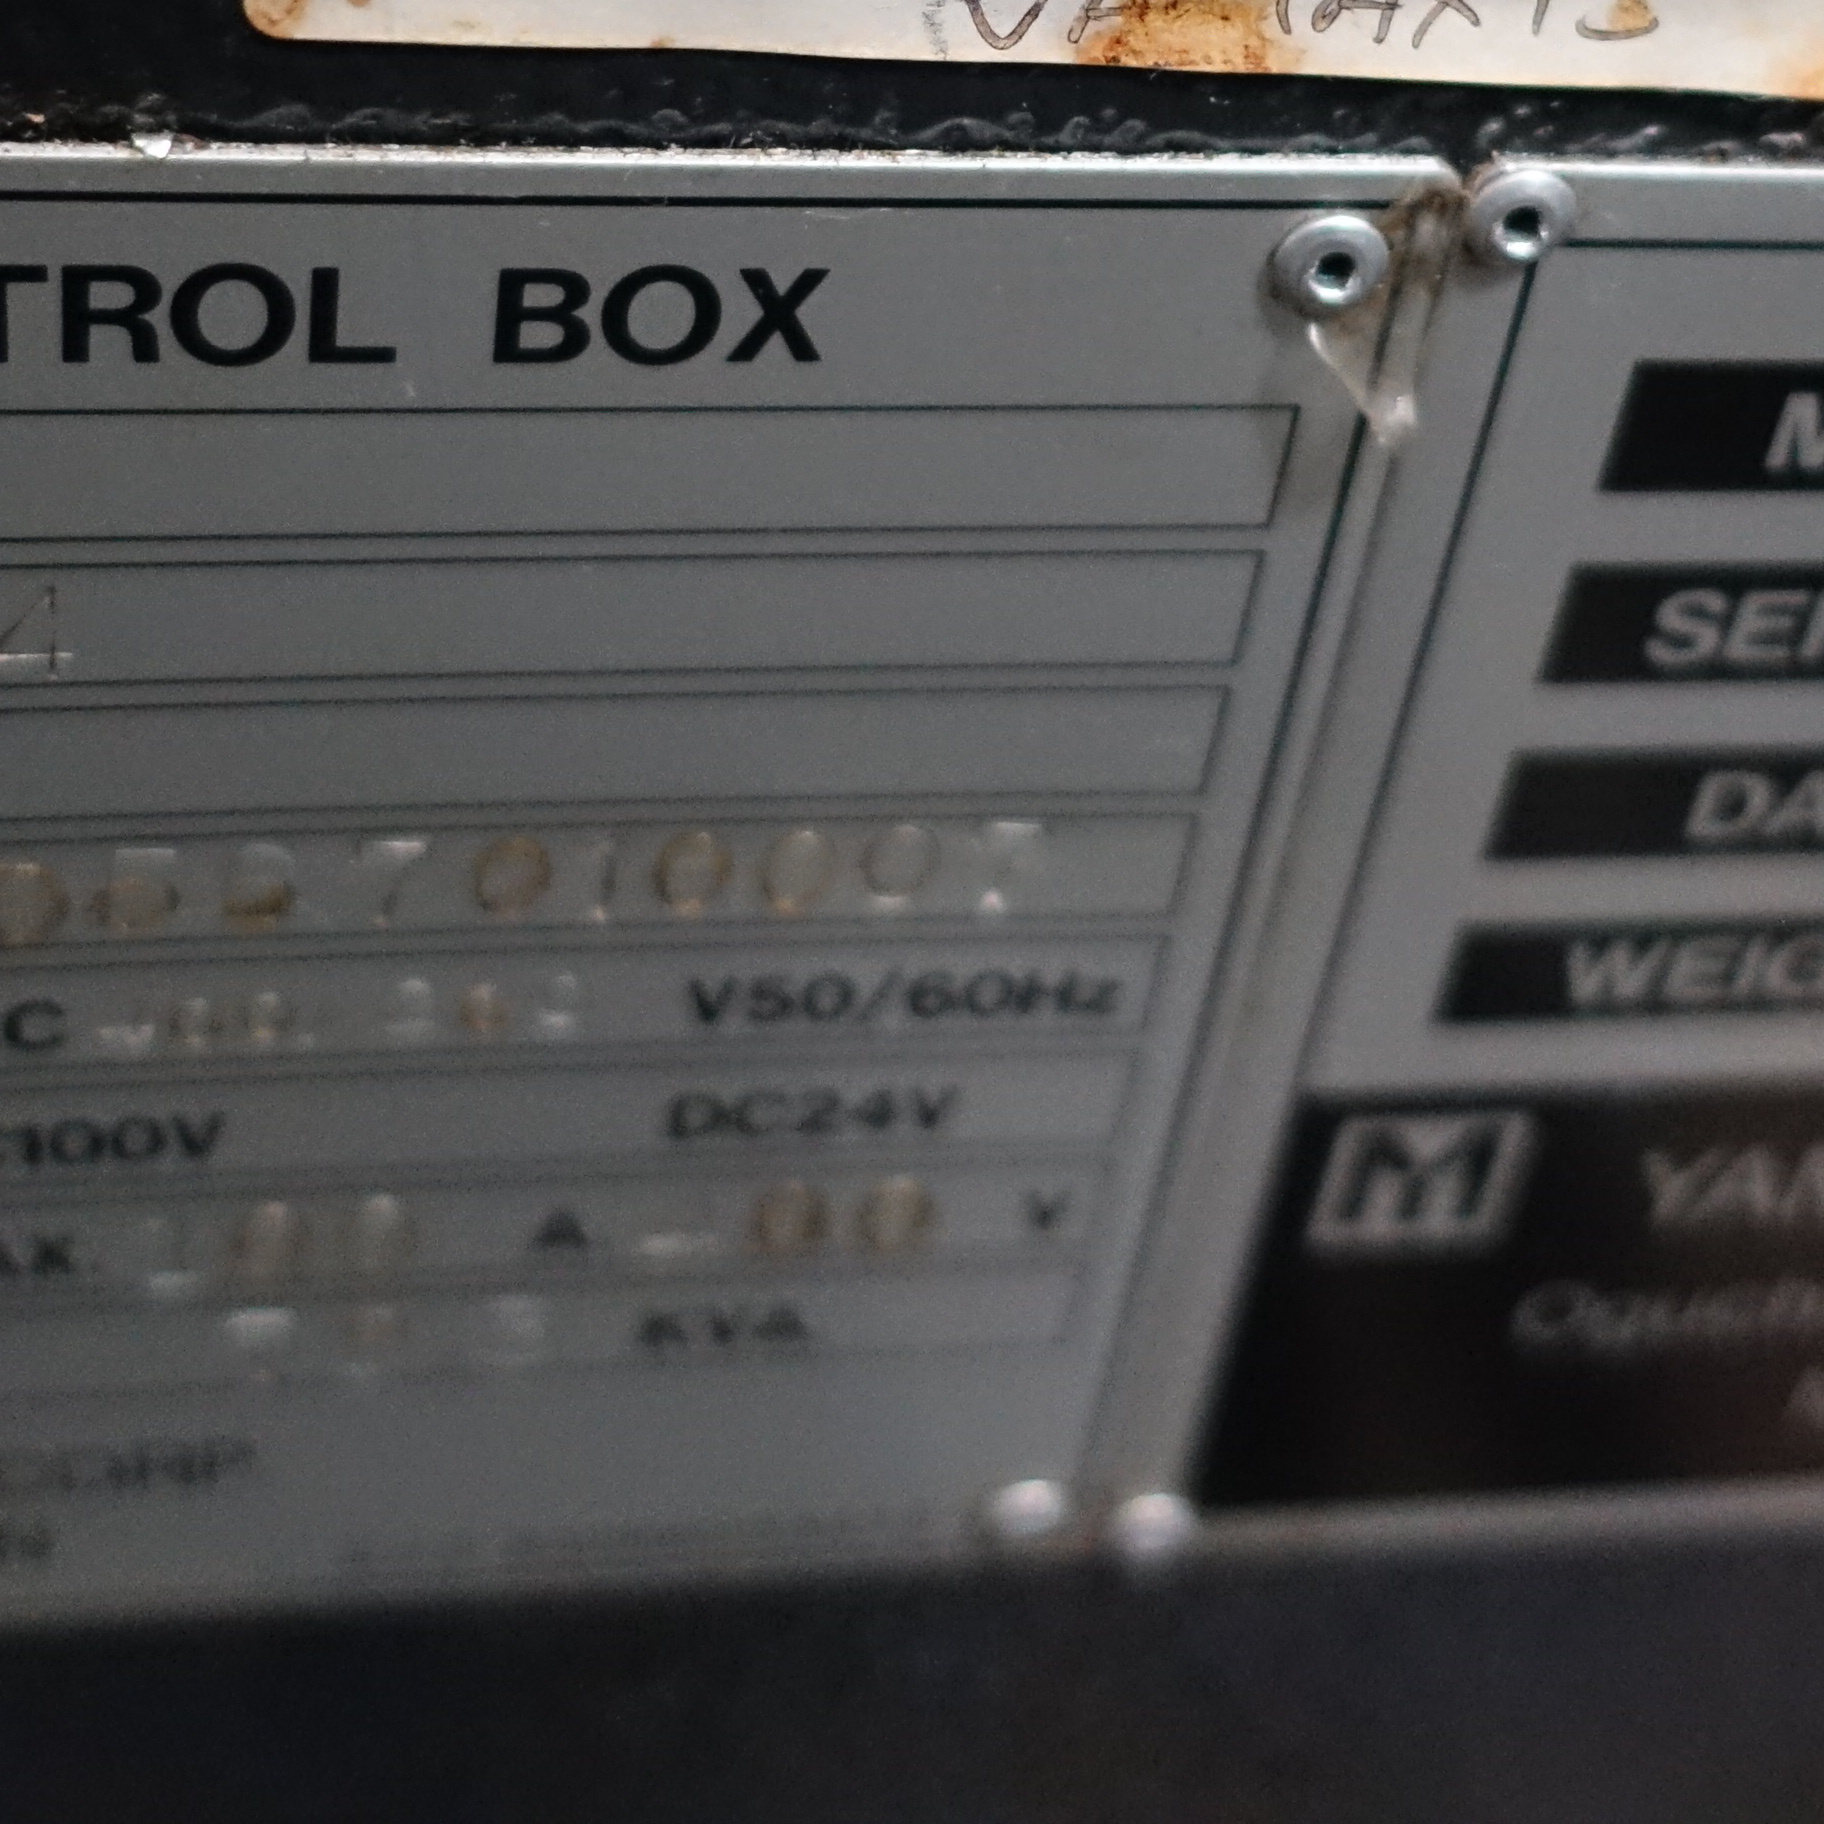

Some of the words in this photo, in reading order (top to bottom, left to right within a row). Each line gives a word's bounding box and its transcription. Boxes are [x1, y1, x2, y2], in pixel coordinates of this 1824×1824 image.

[493, 265, 832, 366] BOX
[686, 969, 1123, 1026] V50/60Hz
[666, 1084, 960, 1141] DC24V
